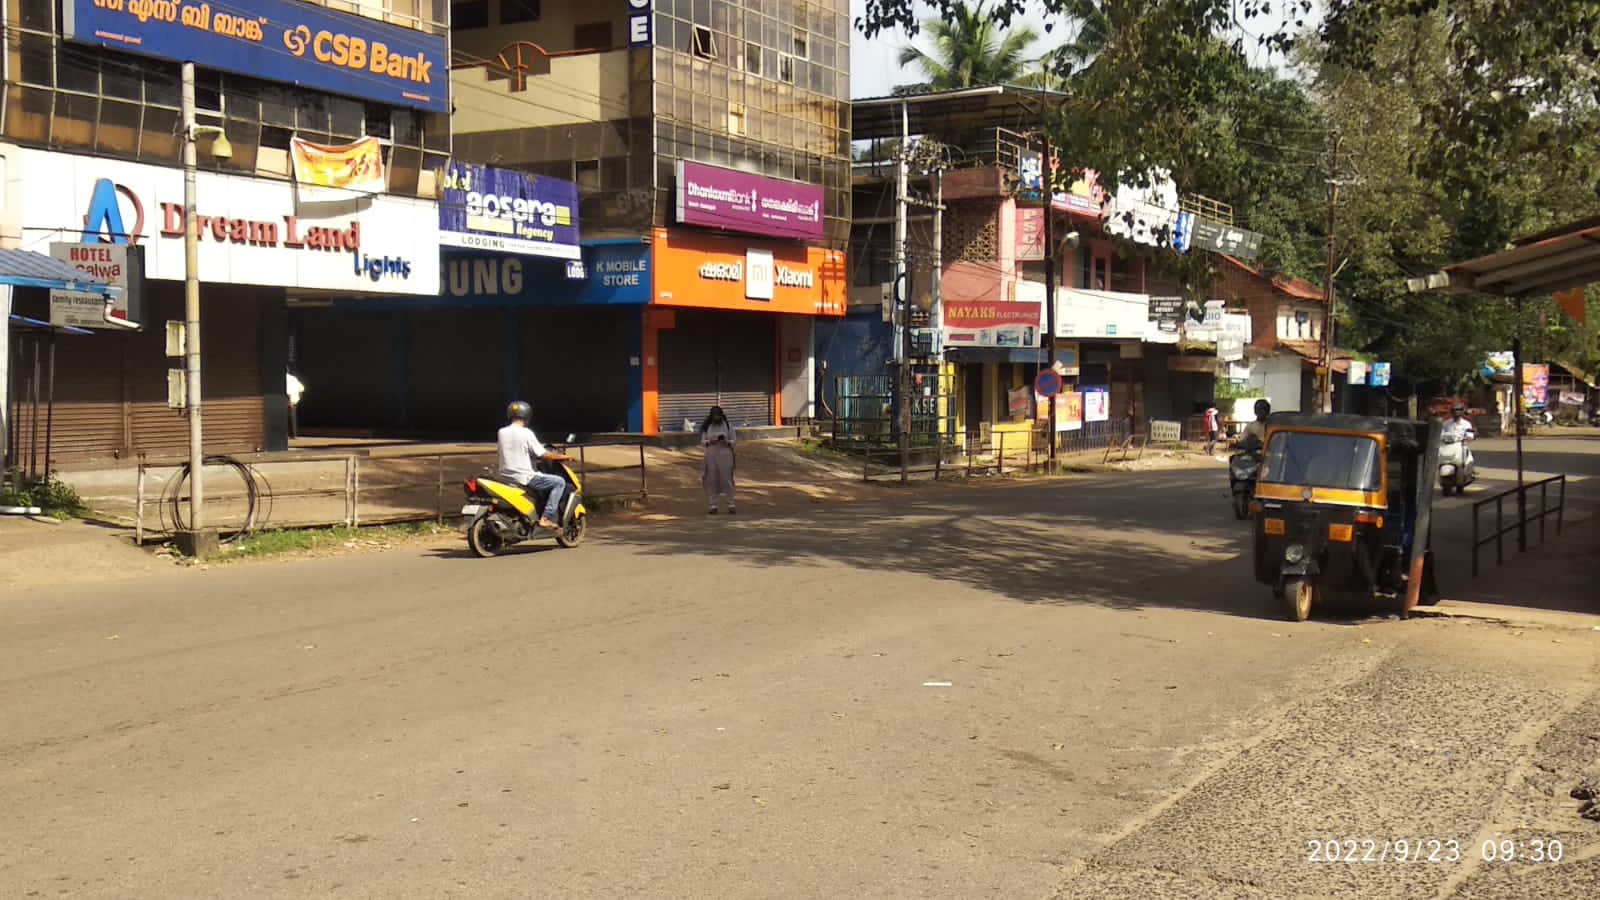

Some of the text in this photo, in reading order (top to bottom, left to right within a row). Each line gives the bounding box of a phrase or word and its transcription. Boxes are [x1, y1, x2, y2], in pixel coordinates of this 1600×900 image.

[313, 29, 431, 84] CSB Bank
[160, 202, 360, 253] Dream Land
[461, 236, 505, 249] LODGING
[70, 247, 112, 262] HOTEL
[354, 252, 411, 280] Lights
[607, 261, 646, 274] MOBILE
[603, 275, 639, 287] STORE
[776, 266, 813, 288] Xiaomi
[949, 307, 996, 319] NAYAKS
